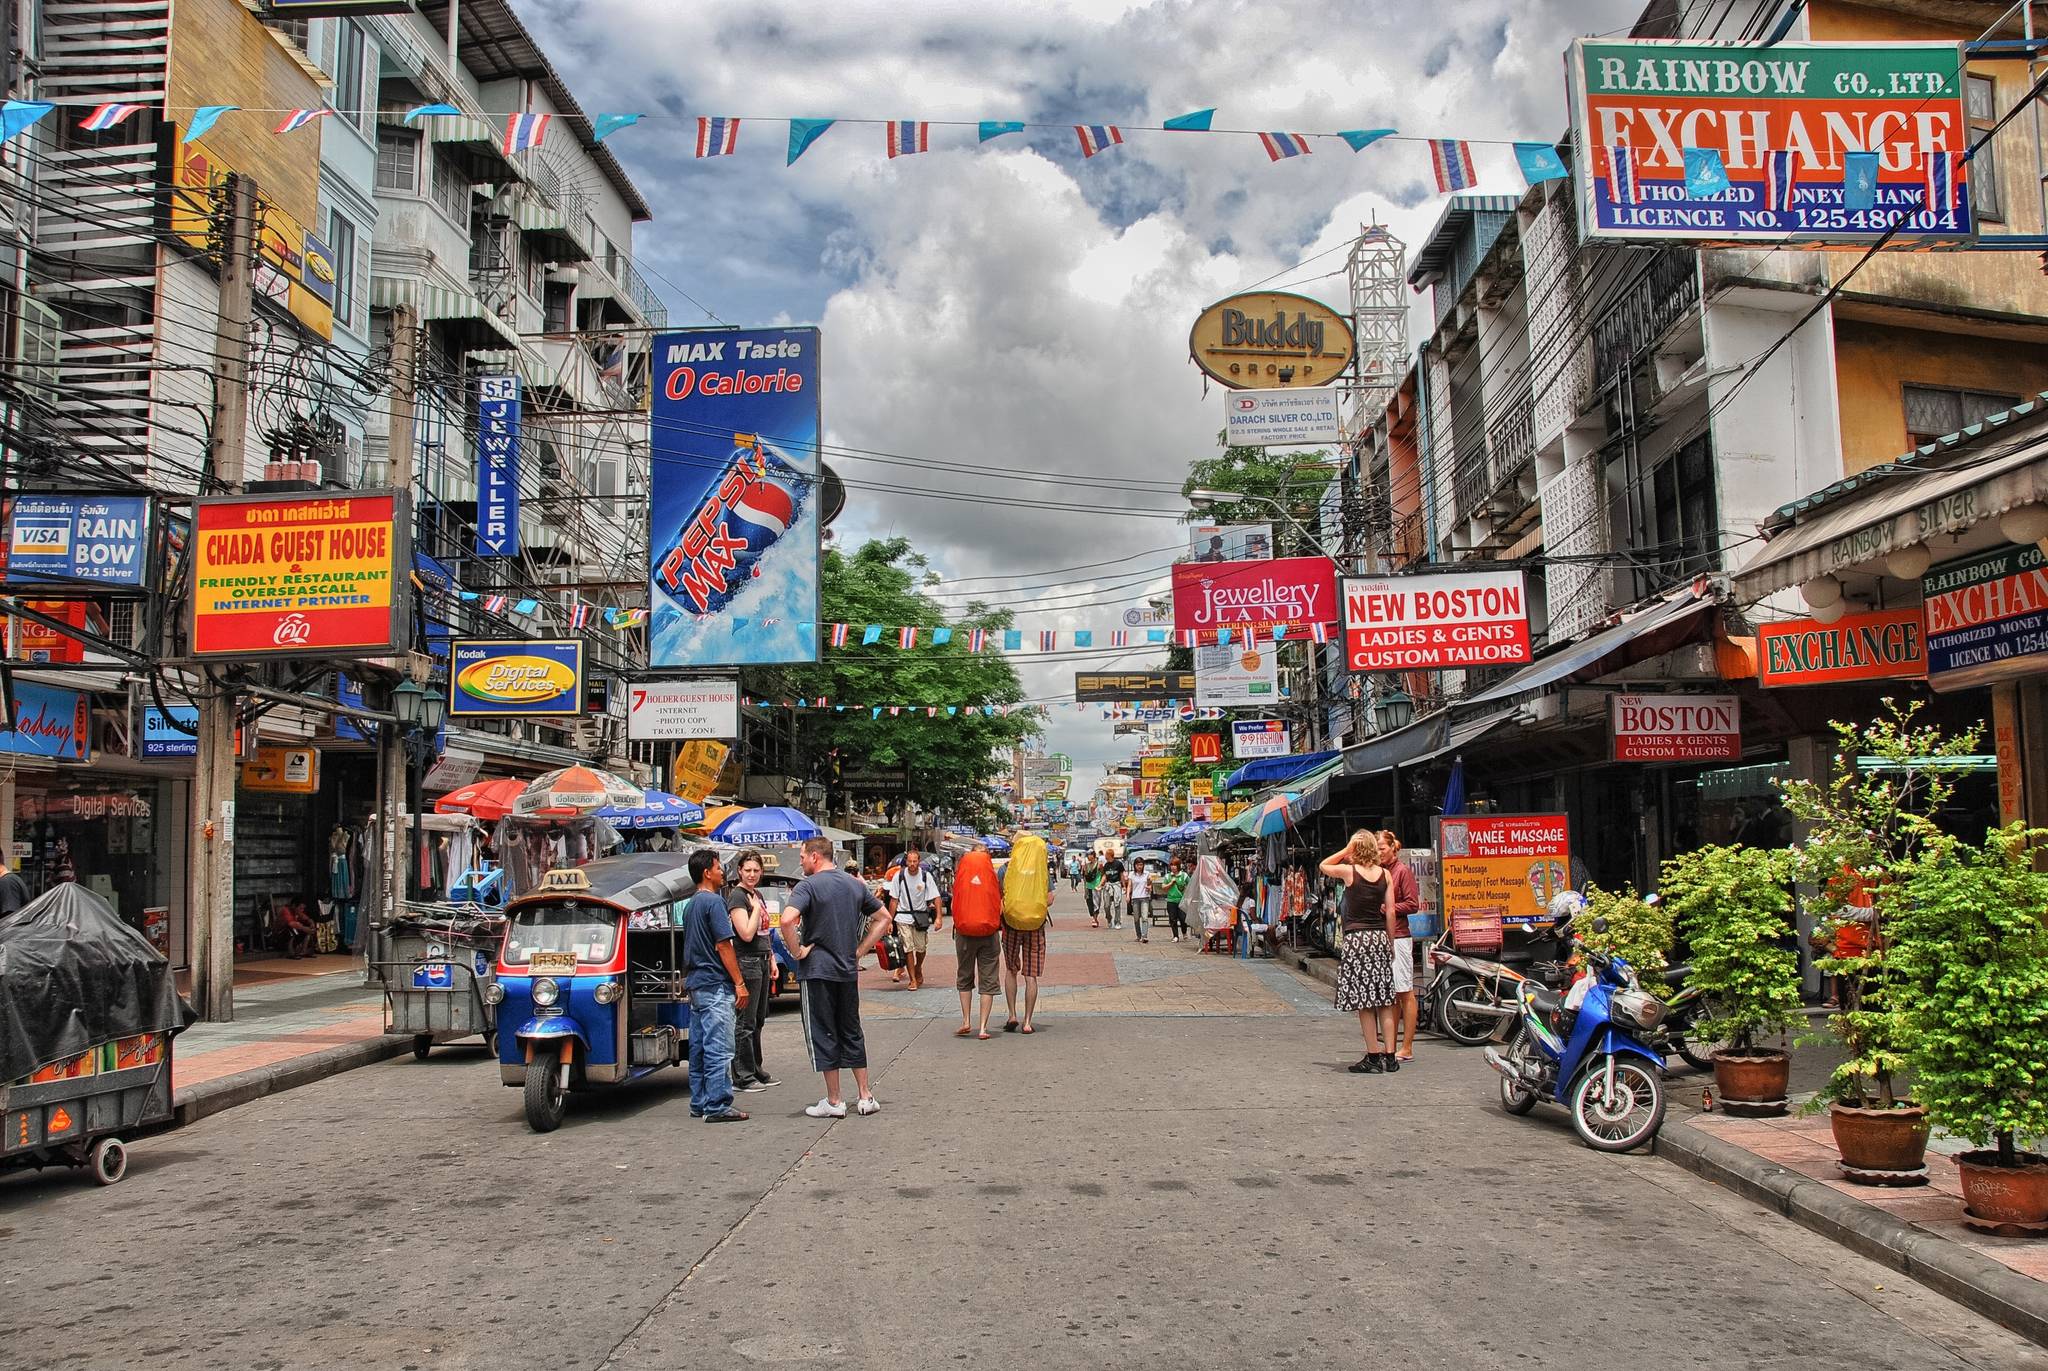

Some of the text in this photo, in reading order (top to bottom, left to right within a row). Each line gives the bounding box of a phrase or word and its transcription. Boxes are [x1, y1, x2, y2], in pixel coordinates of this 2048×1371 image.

[1598, 58, 1952, 97] RAINBOW CO.,LTD.
[1595, 106, 1951, 172] EXCHANGE
[1613, 208, 1959, 229] LICENCE NO. 125480104
[1222, 308, 1324, 356] Buddy
[667, 339, 801, 364] MAX Taste
[486, 380, 513, 397] S.P.
[665, 366, 803, 401] 0 Calorie
[1230, 412, 1335, 425] DARACH SILVER CO.,LTD.
[485, 403, 512, 553] JEWELLERY
[77, 519, 136, 539] RAIN
[660, 456, 757, 591] PEPSI
[22, 529, 61, 543] VISA
[1831, 518, 1899, 565] RAINBOW
[206, 527, 386, 566] CHADA GUEST HOUSE
[75, 544, 136, 565] BOW
[75, 567, 133, 578] 92.5 Silver
[289, 563, 302, 573] &
[681, 522, 748, 612] MAX
[199, 570, 388, 588] FRIENDLY RESTAURANT
[231, 584, 358, 598] OVERSEASCALL
[214, 598, 291, 610] INTERNET
[1349, 586, 1521, 624] NEW BOSTON
[1215, 605, 1303, 623] LAND
[1217, 621, 1257, 629] STERLING
[1360, 625, 1514, 647] LADIES & GENTS
[1928, 615, 2042, 651] AUTHORIZED MONEY
[457, 650, 486, 659] Kodak
[1354, 644, 1523, 667] CUSTOM TAILORS
[1765, 622, 1921, 675] EXCHANGE
[1949, 645, 1991, 668] LICENCE
[1994, 642, 2013, 659] NO.
[490, 664, 550, 680] Digital
[484, 677, 557, 691] Services
[1078, 676, 1167, 690] BRICK
[647, 695, 680, 704] HOLDER
[680, 694, 707, 703] GUEST
[708, 694, 735, 703] HOUSE
[1620, 697, 1642, 706] NEW
[1135, 709, 1175, 719] PEPSI
[1620, 706, 1733, 731] BOSTON
[1240, 732, 1284, 745] 99 FASHION
[1628, 736, 1727, 745] LADIES & GENTS
[148, 743, 197, 754] 925 sterling
[1625, 746, 1730, 757] CUSTOM TAILORS
[73, 795, 151, 820] Digital Services
[602, 816, 631, 826] PEPSI
[683, 810, 703, 822] PEPSI
[1469, 829, 1565, 844] YANEE MASSAGE
[1478, 844, 1558, 856] Thai Healing Arts
[1450, 864, 1487, 874] Thai Massage
[548, 873, 579, 885] TAXI
[1450, 879, 1481, 888] Reflexology
[1500, 875, 1527, 887] Massage)
[1451, 891, 1510, 901] Aromatic Oil Massage
